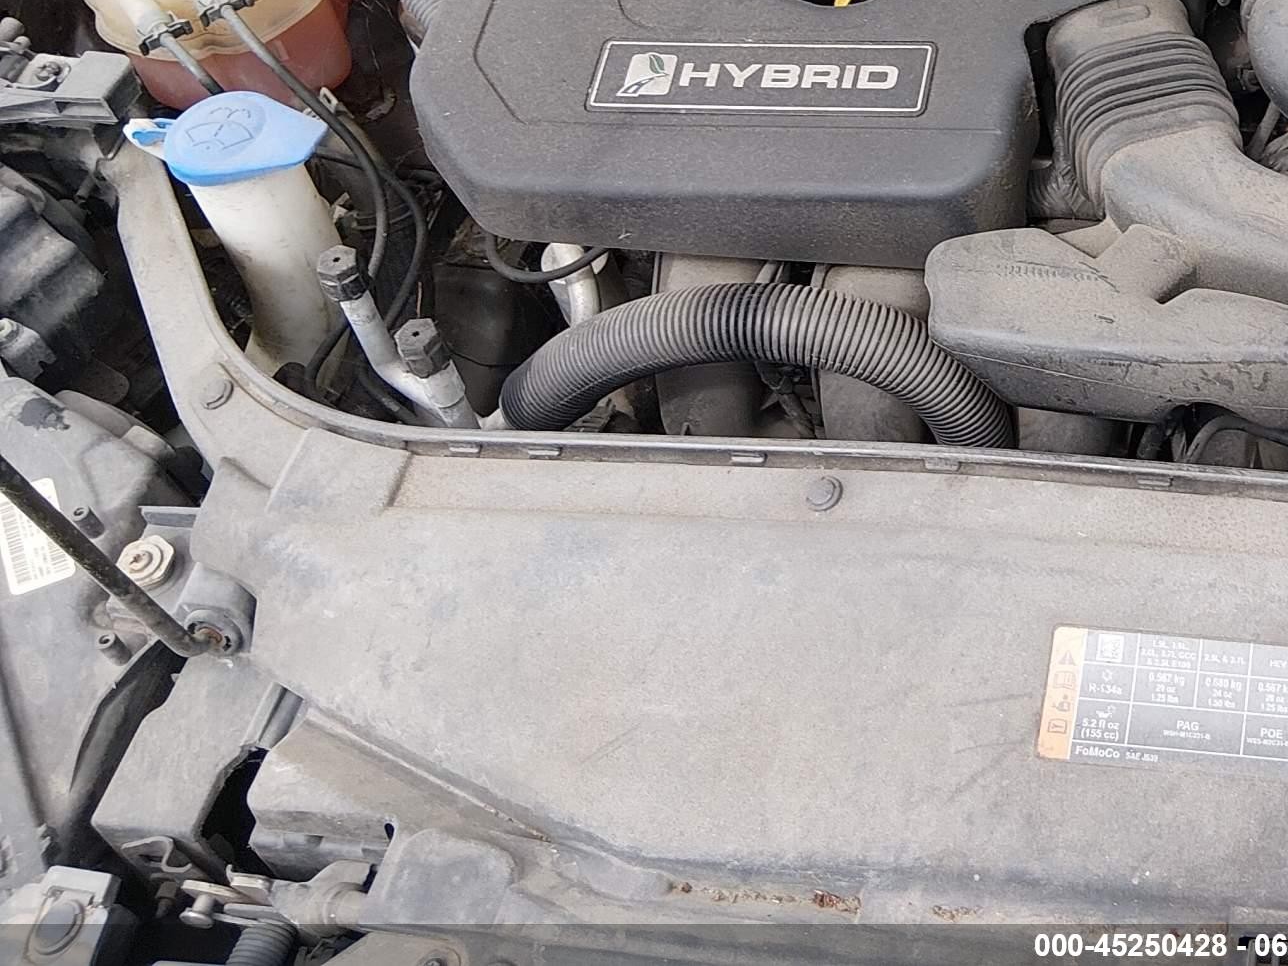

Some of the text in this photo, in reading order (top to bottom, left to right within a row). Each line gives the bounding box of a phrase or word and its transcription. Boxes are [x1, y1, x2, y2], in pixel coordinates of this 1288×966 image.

[678, 61, 899, 91] HYBRID
[1082, 718, 1097, 728] 5.2
[1107, 721, 1120, 730] oz
[1176, 719, 1200, 731] PAG
[1080, 727, 1119, 742] (155 cc)
[1260, 727, 1284, 739] POE
[1075, 745, 1121, 759] FoMoCo
